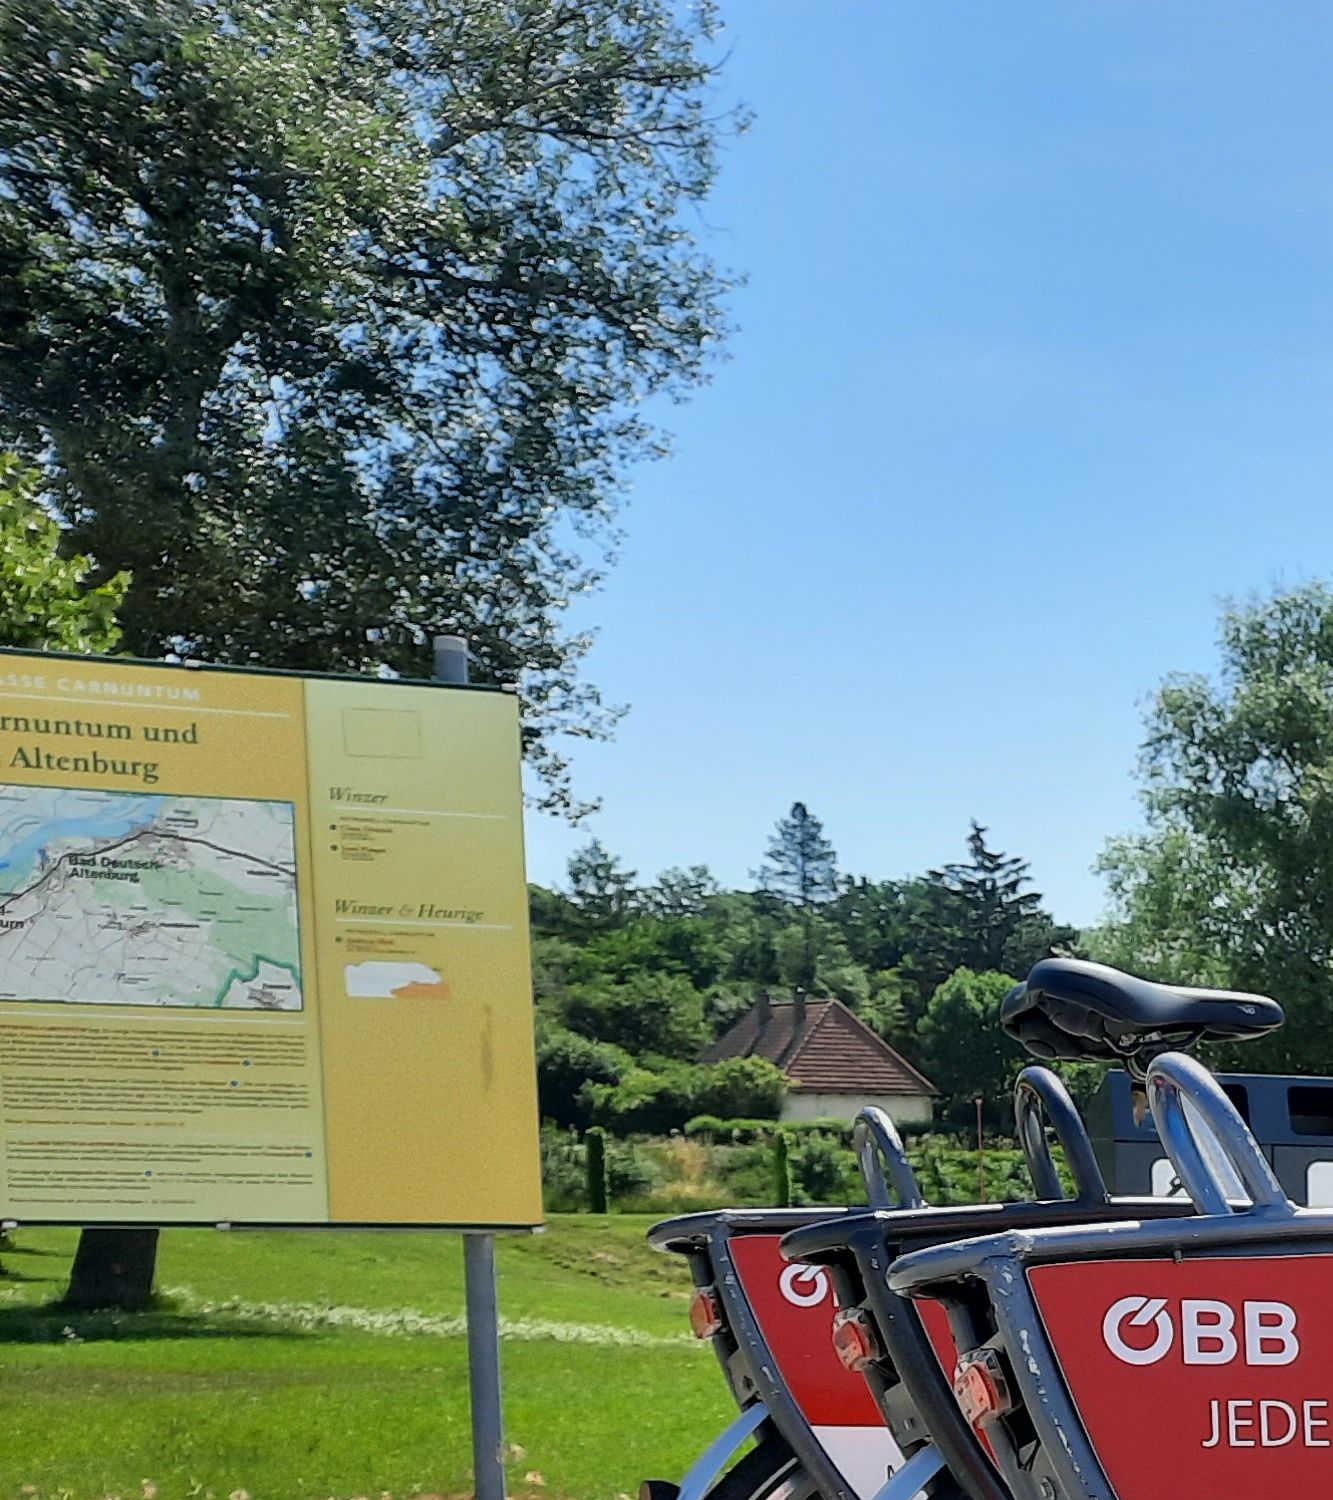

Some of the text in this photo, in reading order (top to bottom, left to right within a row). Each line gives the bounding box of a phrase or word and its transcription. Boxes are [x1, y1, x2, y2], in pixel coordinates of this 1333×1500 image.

[57, 677, 201, 702] CARNUNTUM
[144, 722, 199, 745] und
[9, 746, 160, 784] Altenburg
[329, 786, 389, 804] Winzer
[335, 899, 395, 915] Winzer
[417, 903, 485, 924] Heurige
[1103, 1296, 1299, 1365] ÖBB
[1202, 1399, 1331, 1448] JEDE
